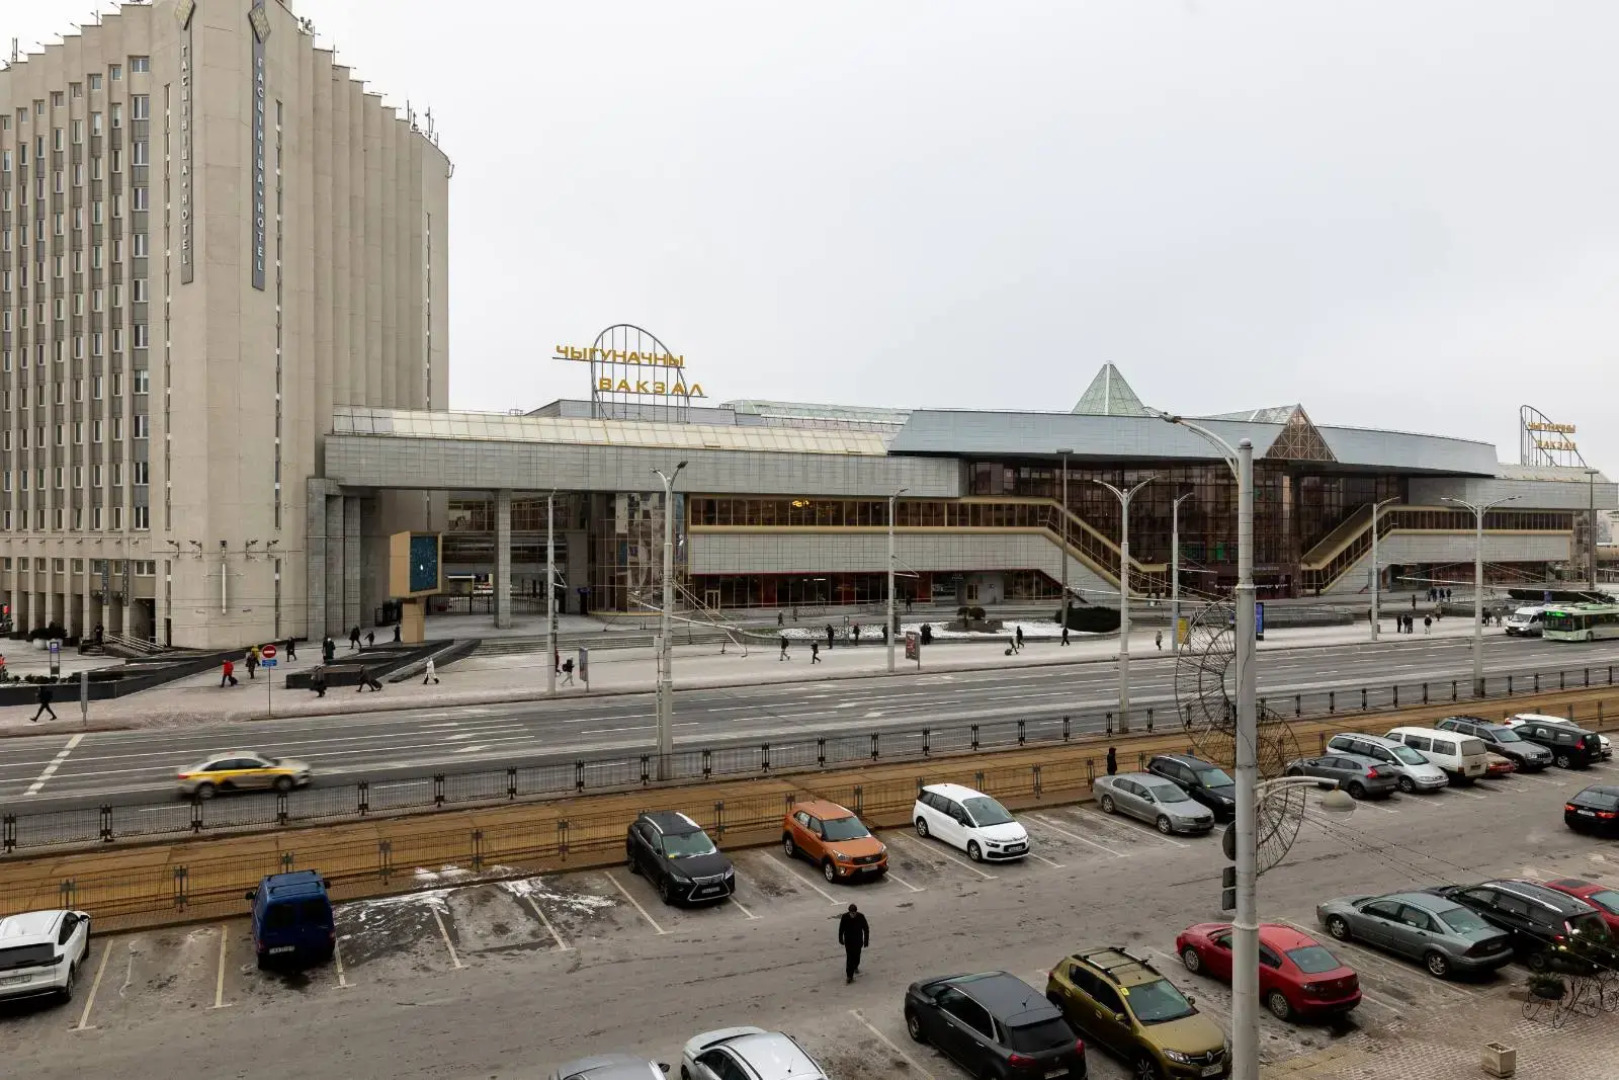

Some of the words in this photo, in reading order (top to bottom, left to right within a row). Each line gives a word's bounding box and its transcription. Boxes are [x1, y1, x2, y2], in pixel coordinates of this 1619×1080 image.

[181, 194, 189, 264] HOTEL
[256, 202, 264, 271] HOTEL
[555, 345, 685, 367] ЧЫГУНАЧНЫ
[599, 377, 704, 396] ВАКЗАЛ
